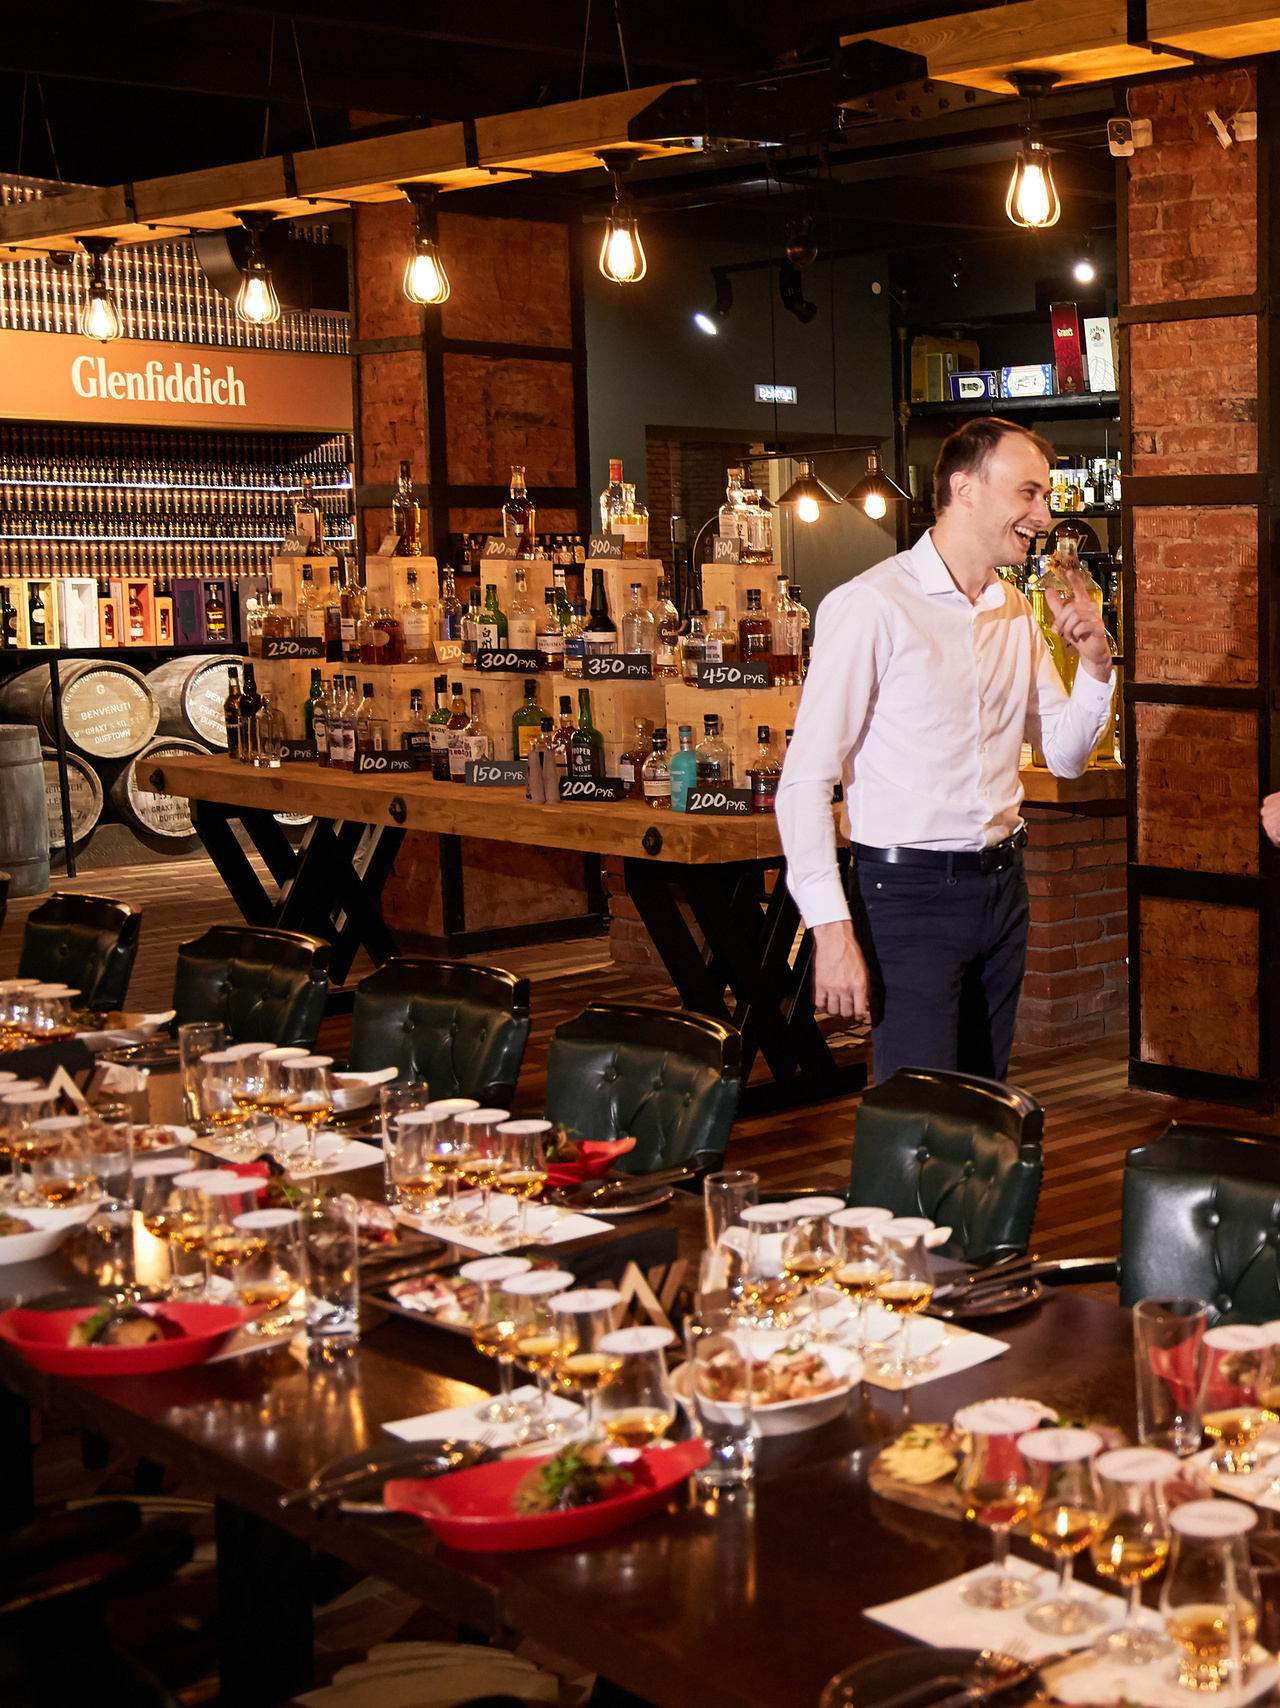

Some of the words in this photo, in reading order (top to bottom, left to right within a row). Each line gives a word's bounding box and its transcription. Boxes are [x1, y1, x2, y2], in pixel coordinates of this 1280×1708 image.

[1056, 328, 1074, 338] Grant's
[71, 355, 247, 407] Glenfiddich
[758, 387, 793, 401] ВЫХОД
[486, 540, 506, 555] 700
[590, 539, 611, 555] 900
[714, 540, 733, 561] 1500
[267, 640, 300, 657] 250
[439, 645, 462, 661] 250
[481, 653, 518, 668] 300
[588, 658, 625, 675] 350
[702, 666, 741, 685] 450
[80, 701, 132, 721] BENVENUTI
[200, 716, 226, 733] DUFFTO
[94, 728, 131, 744] DUFFTOWN
[359, 753, 388, 771] 100
[473, 764, 502, 783] 150
[562, 781, 596, 797] 200
[690, 793, 727, 811] 200
[159, 812, 191, 823] DUFFTOW
